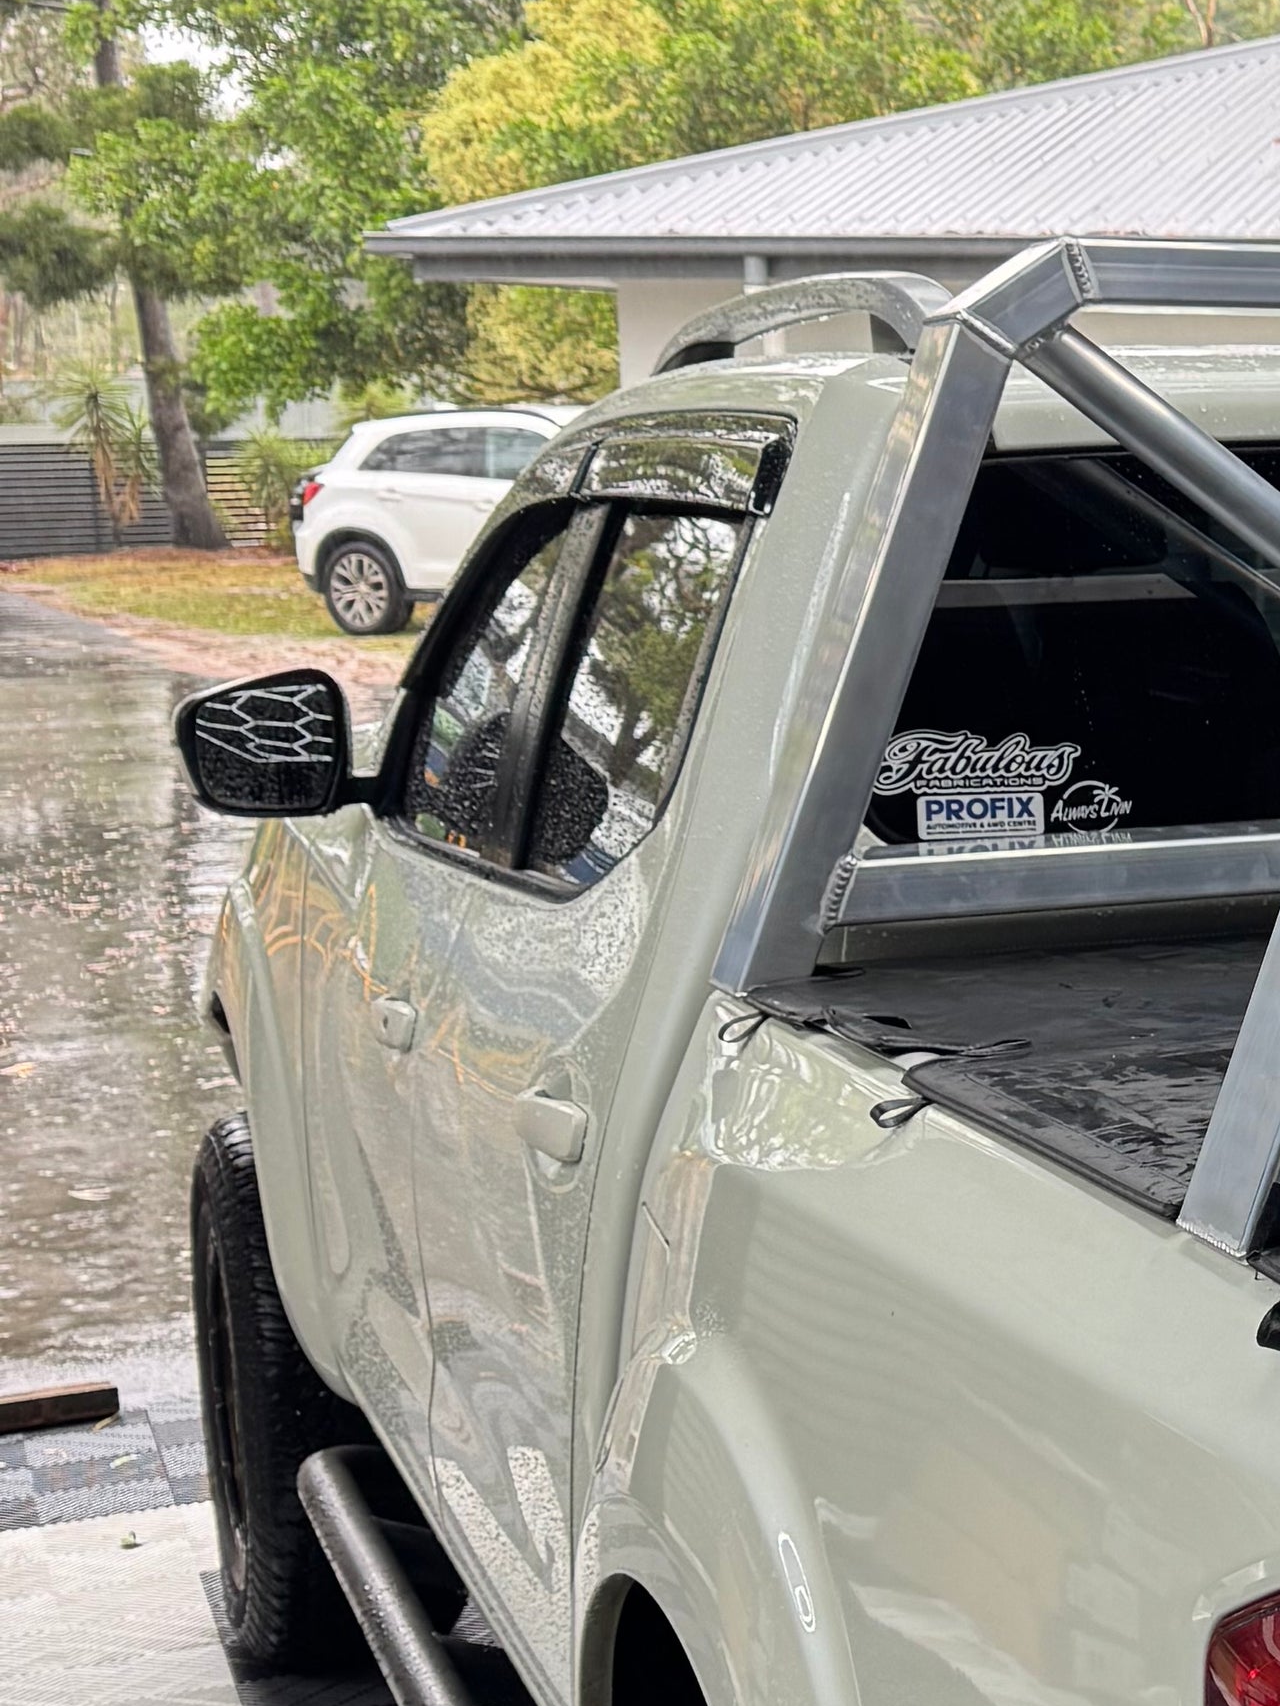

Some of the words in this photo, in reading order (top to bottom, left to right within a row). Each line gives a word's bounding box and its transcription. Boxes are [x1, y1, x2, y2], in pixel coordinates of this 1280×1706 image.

[879, 731, 1079, 786] Fabulous
[916, 777, 1043, 788] FABRICATIONS
[925, 796, 1035, 821] PROFIX
[926, 822, 977, 830] AUTOMOTIVE
